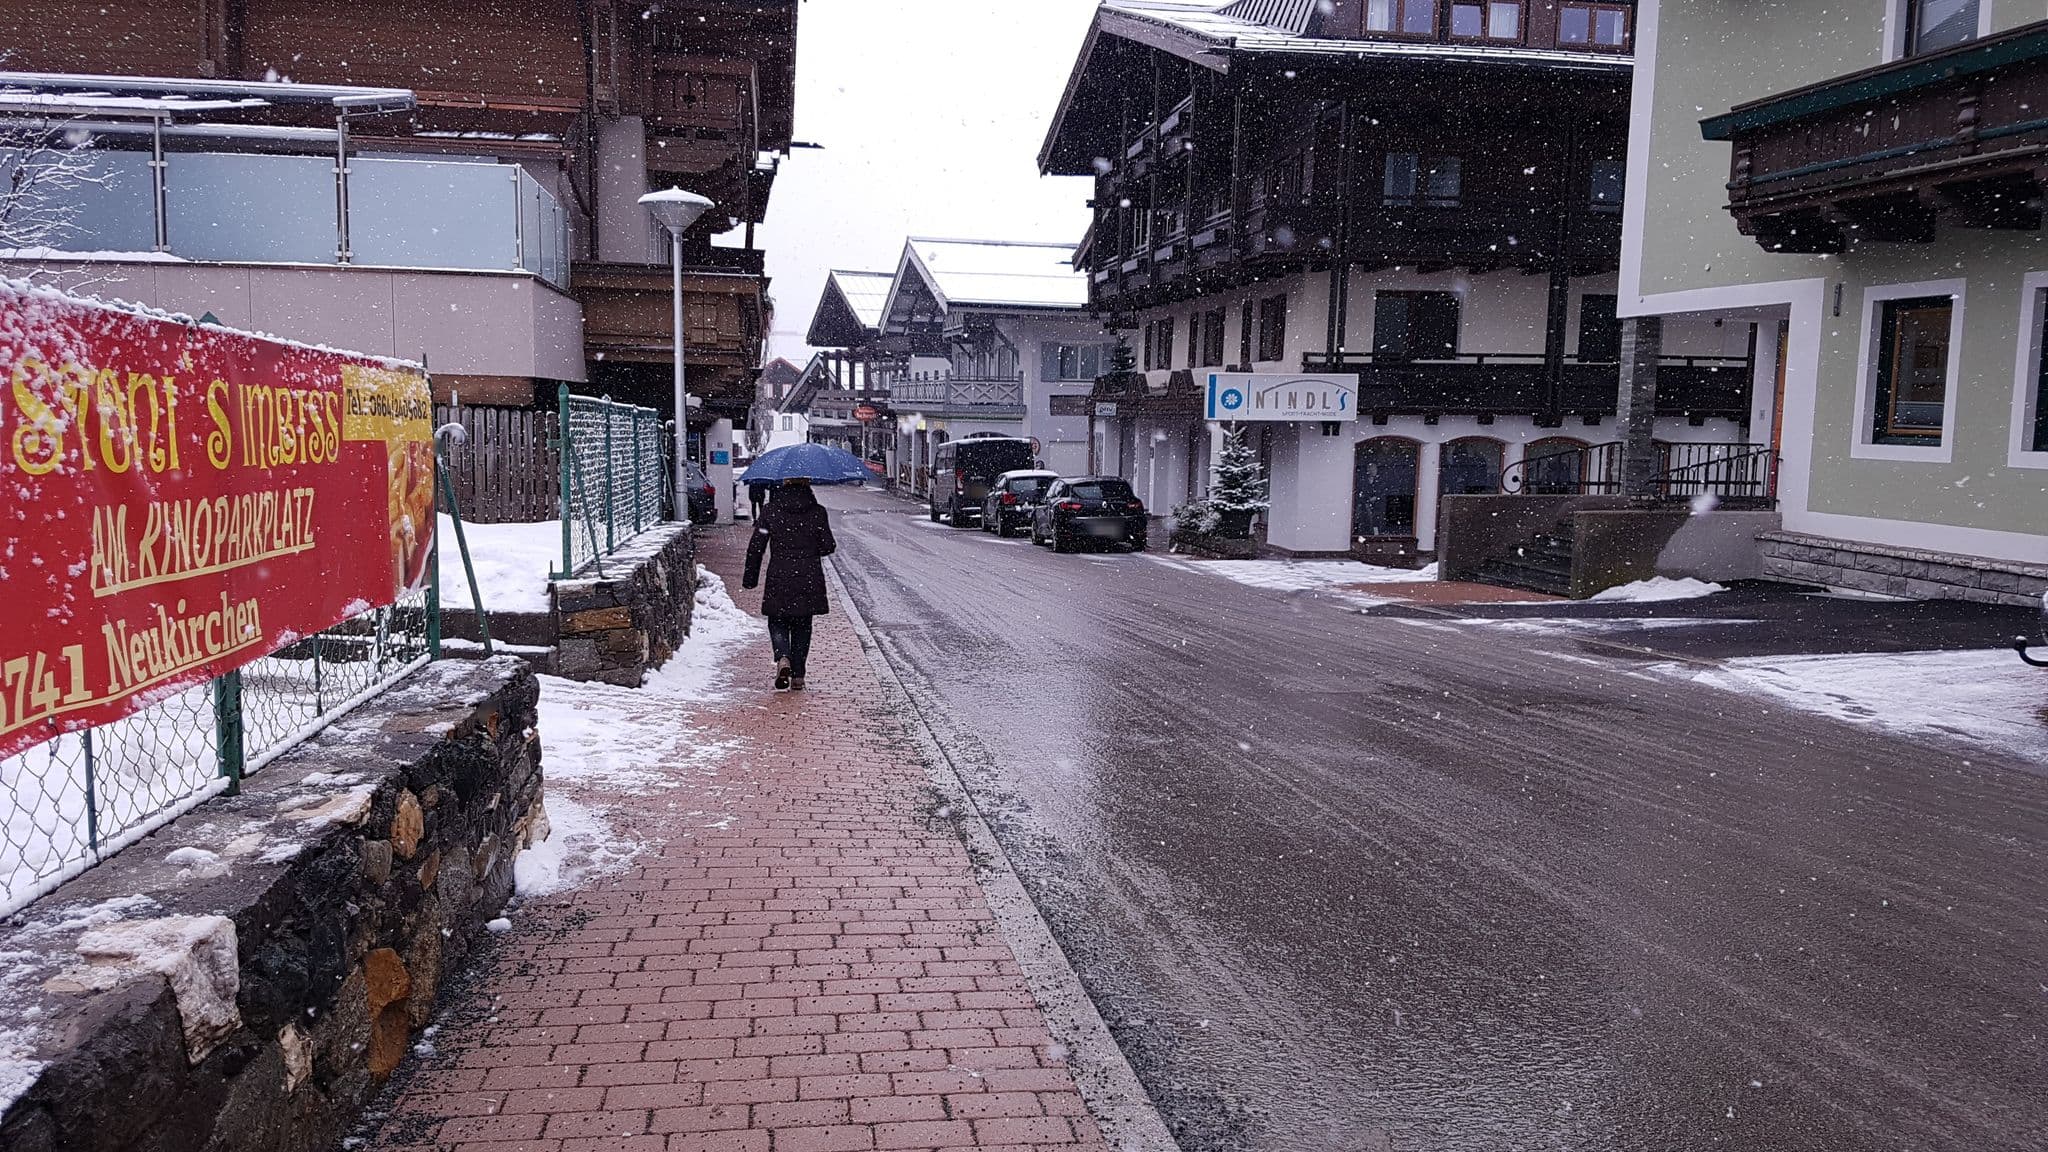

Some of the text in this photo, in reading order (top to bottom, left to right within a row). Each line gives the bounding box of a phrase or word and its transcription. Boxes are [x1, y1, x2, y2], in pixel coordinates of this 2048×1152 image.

[238, 382, 339, 469] IMBISS
[1255, 389, 1347, 411] NINDL'S
[90, 488, 315, 588] AM KINOPARKPLATZ
[0, 591, 262, 728] 741 Neukirchen
